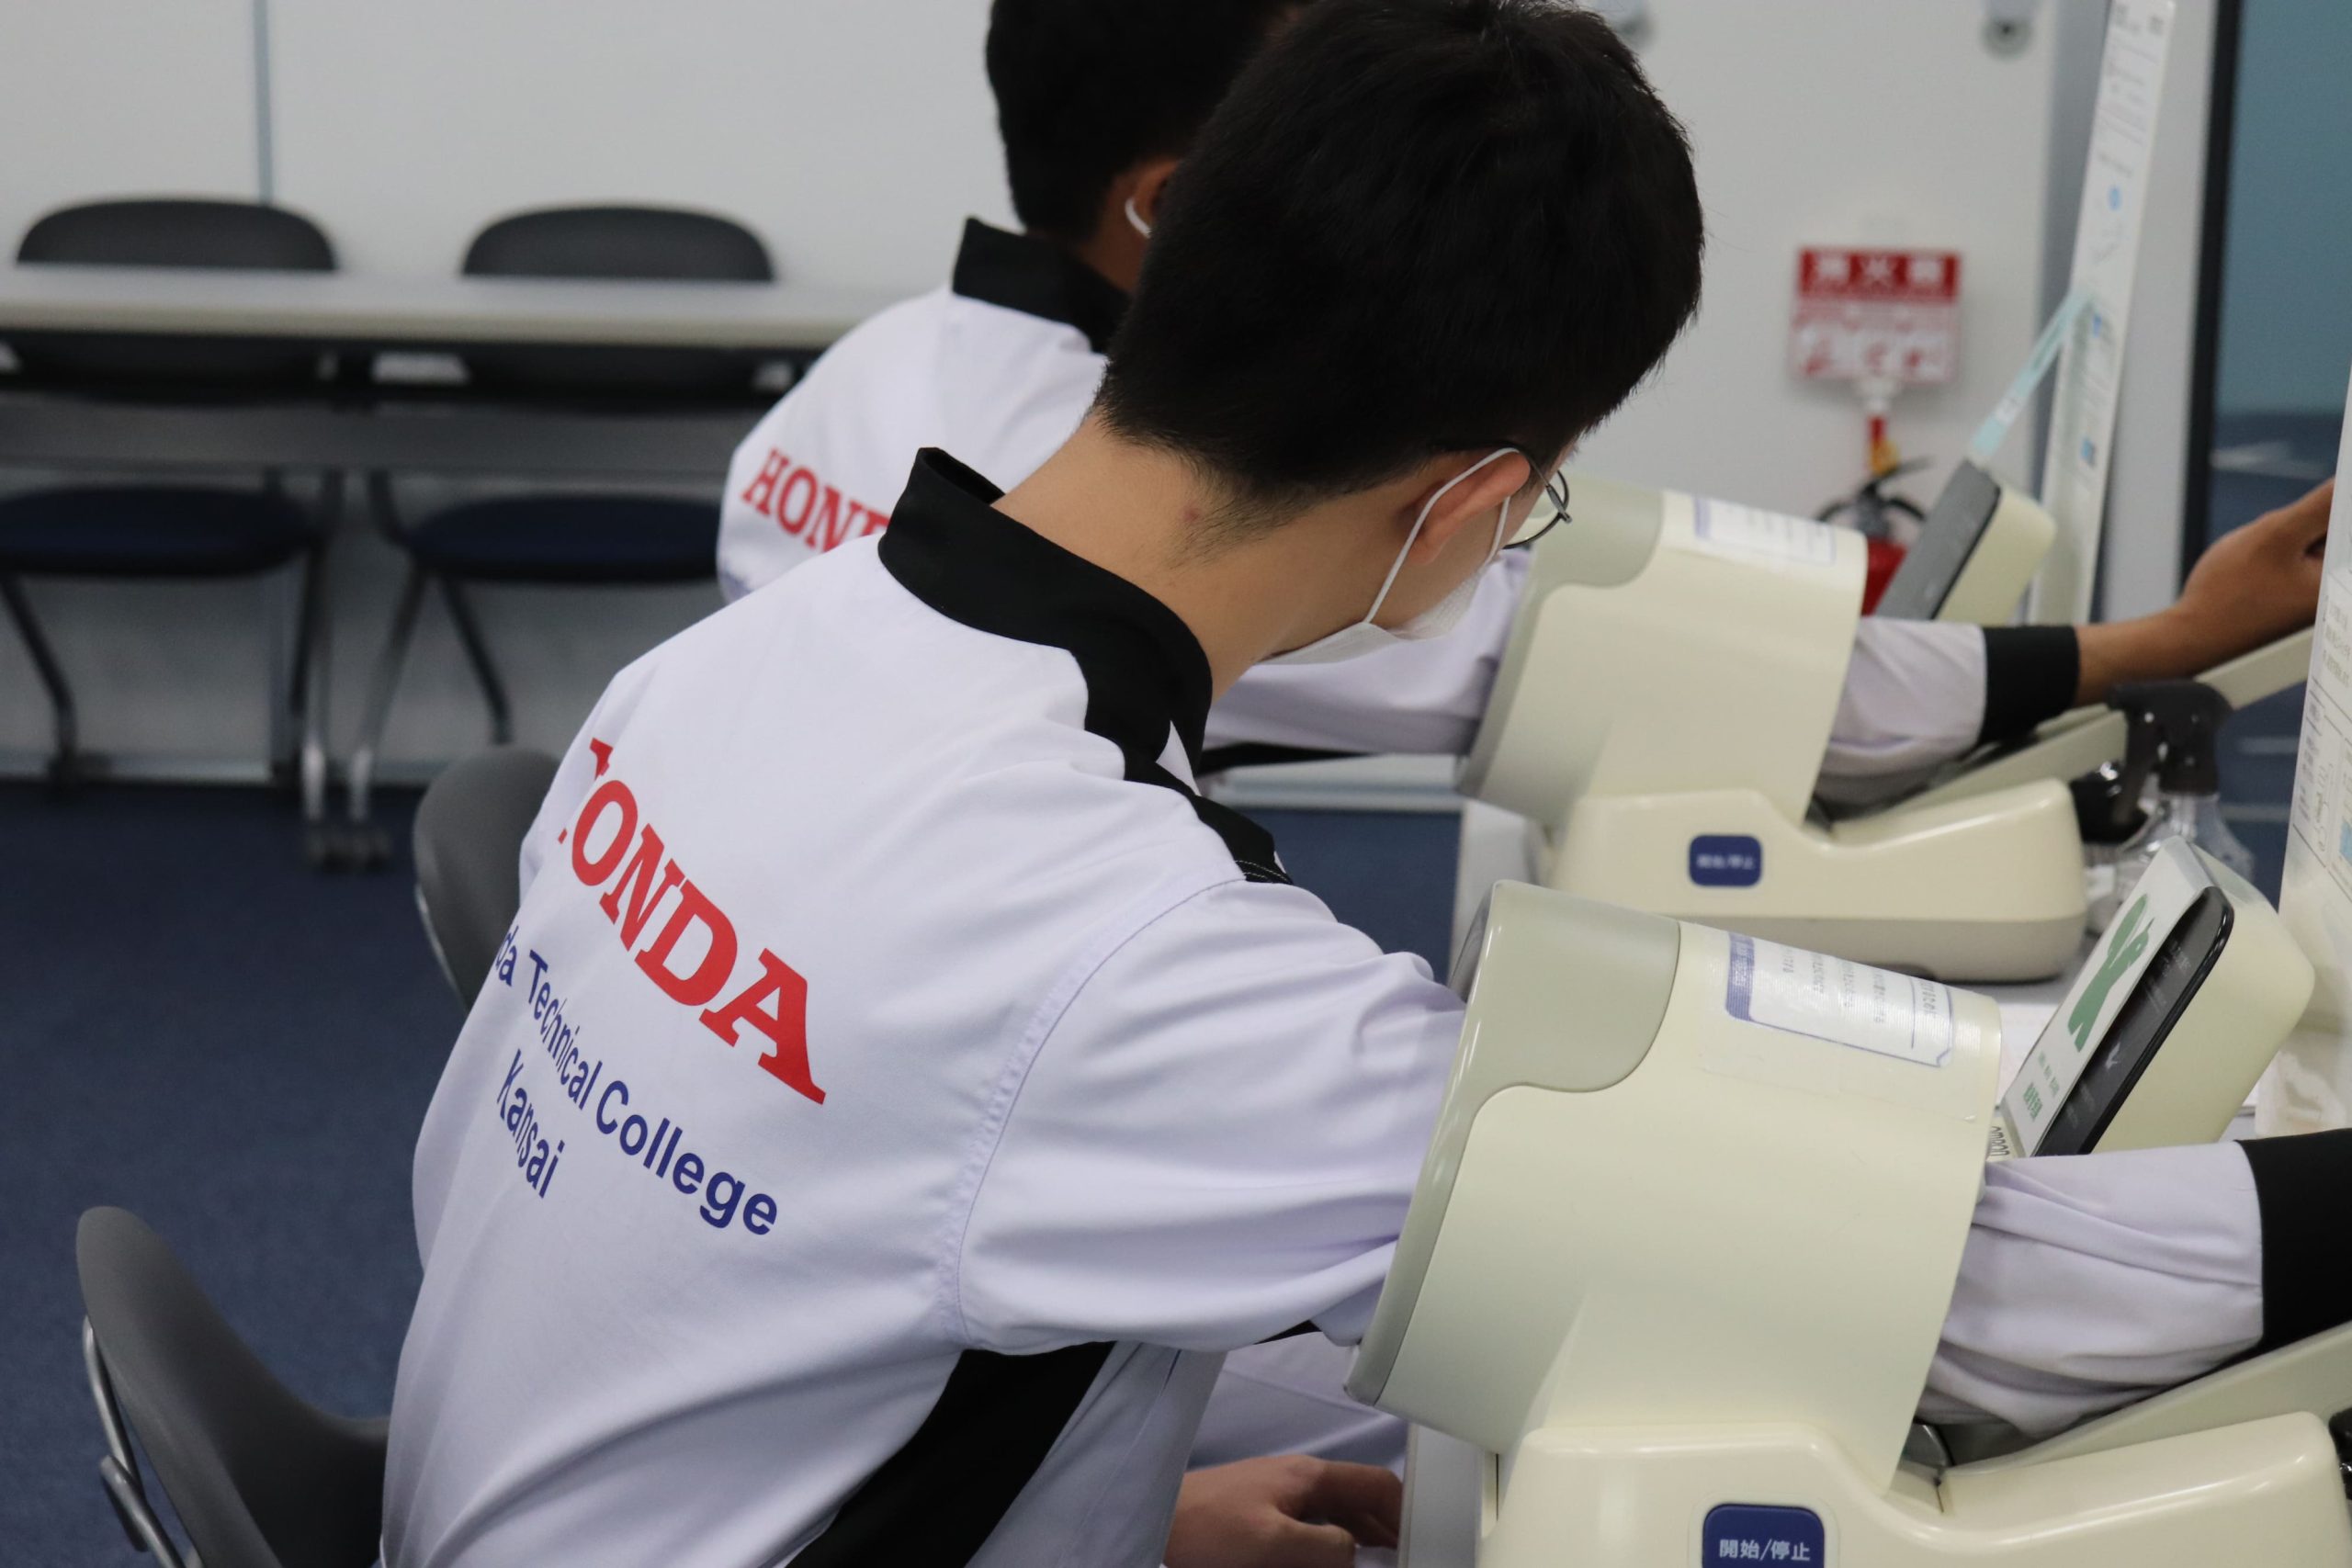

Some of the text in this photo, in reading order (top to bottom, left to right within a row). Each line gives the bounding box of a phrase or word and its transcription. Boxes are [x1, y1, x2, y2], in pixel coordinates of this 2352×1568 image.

[559, 738, 826, 1104] ONDA
[497, 1049, 565, 1198] Kansai
[529, 949, 603, 1111] Technical
[596, 1080, 778, 1235] College
[1719, 1539, 1811, 1562] 開始/停止
